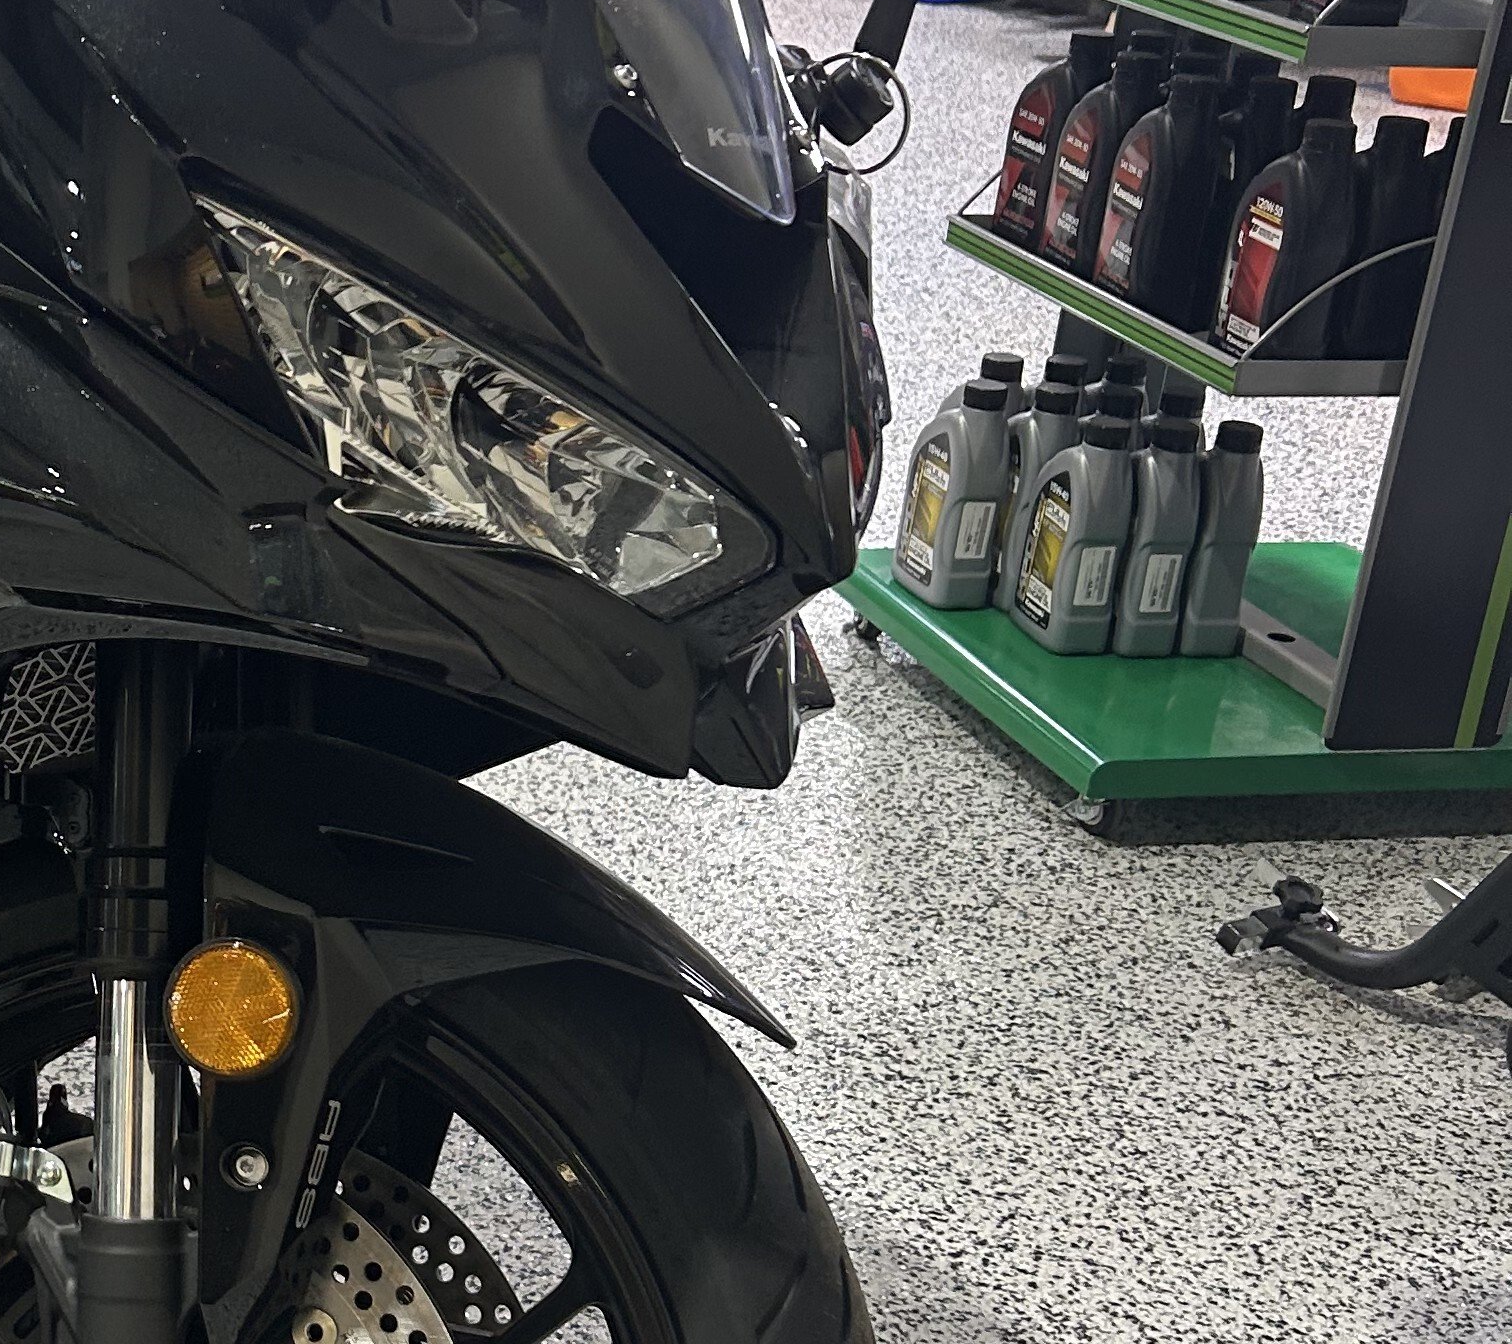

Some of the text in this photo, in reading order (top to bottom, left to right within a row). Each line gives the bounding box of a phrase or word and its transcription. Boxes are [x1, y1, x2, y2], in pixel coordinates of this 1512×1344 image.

[1012, 130, 1047, 156] Kawasaki
[1059, 155, 1090, 183] Kawasaki
[1112, 181, 1144, 210] Kawasaki
[295, 1099, 341, 1229] ABS
